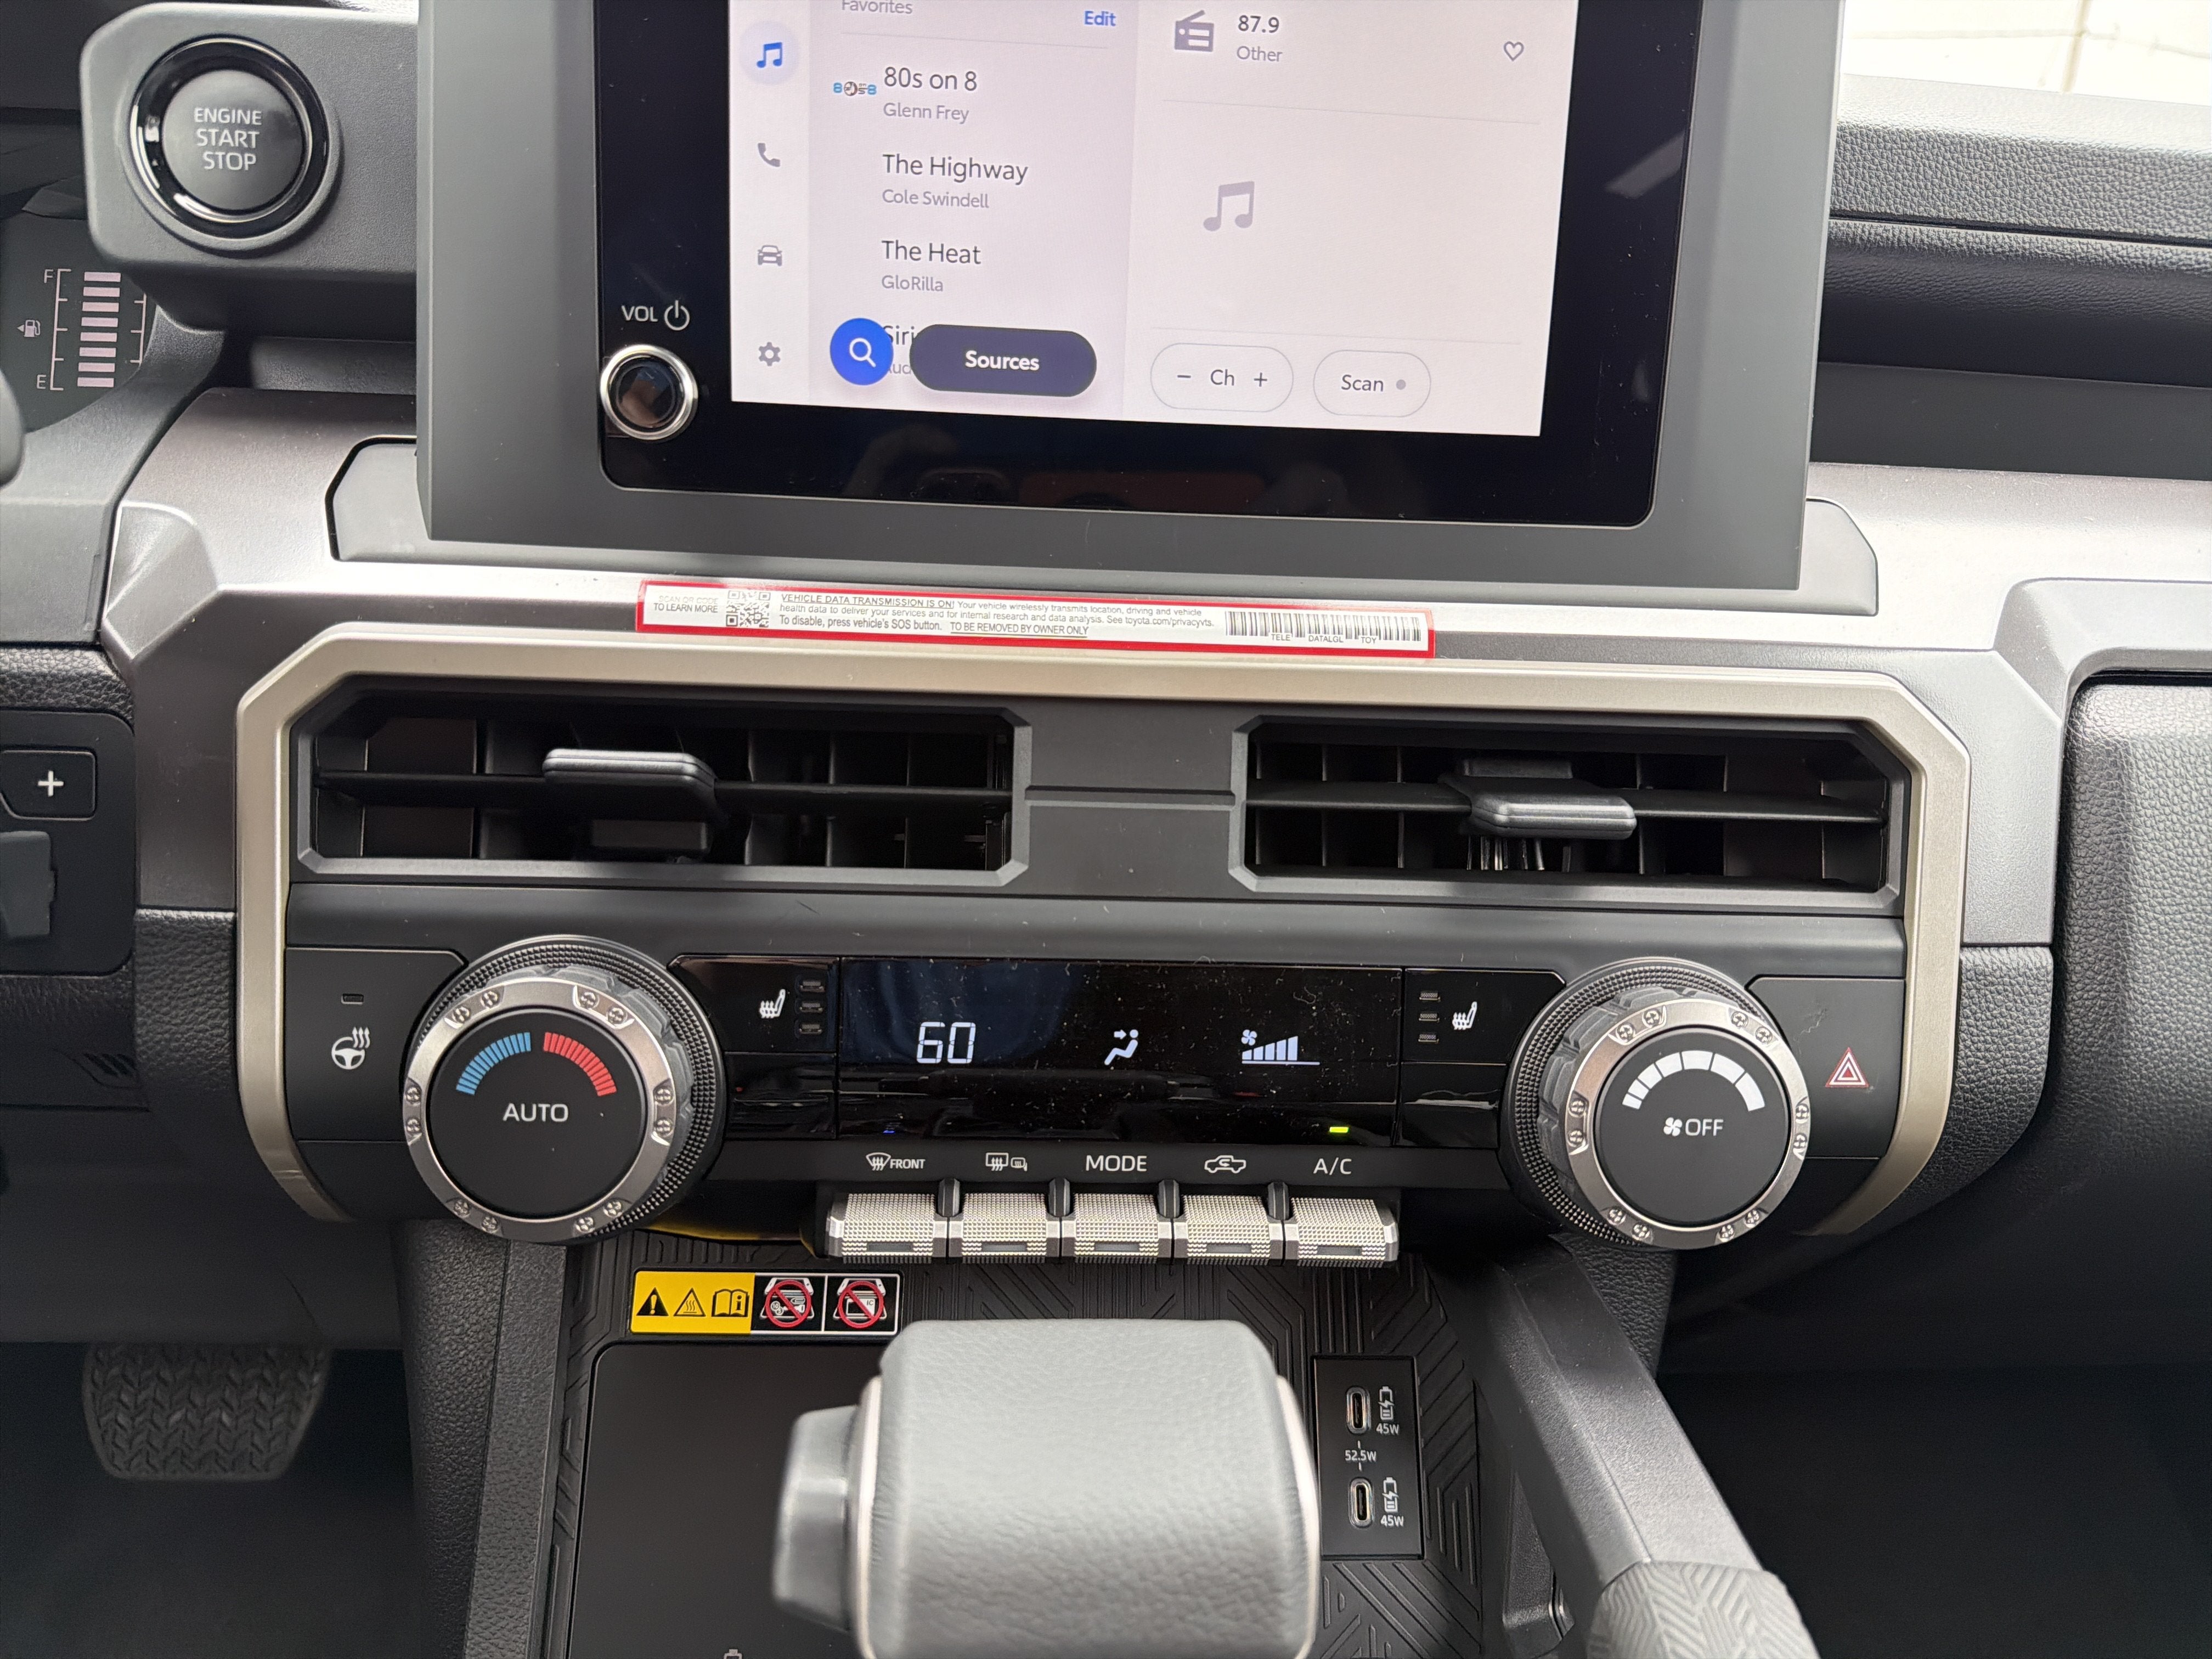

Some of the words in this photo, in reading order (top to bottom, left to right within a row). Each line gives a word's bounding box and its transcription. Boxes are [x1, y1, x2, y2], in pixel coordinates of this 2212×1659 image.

[1084, 10, 1116, 27] Edit
[1237, 15, 1280, 34] 87.9
[1236, 46, 1283, 63] Other
[884, 66, 923, 88] 80s
[929, 74, 958, 90] on
[964, 71, 978, 92] 8
[194, 107, 262, 126] ENGINE
[883, 102, 932, 119] Glenn
[936, 105, 969, 125] Frey
[196, 128, 259, 149] START
[203, 151, 257, 171] STOP
[882, 153, 923, 176] The
[929, 156, 1029, 185] Highway
[882, 189, 919, 205] Cole
[922, 191, 990, 208] Swindell
[881, 239, 922, 262] The
[928, 242, 981, 266] Heat
[43, 269, 54, 284] F
[881, 274, 944, 293] GloRilla
[620, 305, 658, 323] VOL
[964, 350, 1040, 371] Sources
[36, 374, 47, 390] E
[1209, 368, 1235, 387] Ch
[1340, 374, 1385, 393] Scan
[653, 603, 665, 611] TO
[666, 603, 692, 612] LEARN
[695, 605, 719, 613] MORE
[780, 603, 806, 612] health
[808, 605, 827, 613] data
[830, 606, 839, 614] to
[841, 606, 869, 615] deliver
[871, 608, 889, 618] your
[891, 609, 927, 617] services
[928, 610, 944, 618] and
[946, 610, 958, 619] for
[960, 611, 991, 619] internal
[993, 612, 1029, 620] research
[1048, 614, 1066, 622] data
[1069, 614, 1104, 625] analysis.
[1106, 615, 1123, 624] See
[781, 594, 822, 603] VEHICLE
[825, 595, 850, 604] DATA
[852, 596, 924, 607] TRANSMISSION
[926, 599, 935, 608] IS
[957, 601, 977, 609] Your
[978, 601, 1007, 610] vehicle
[1009, 603, 1049, 613] wirelessly
[1051, 605, 1088, 613] transmits
[1126, 607, 1154, 616] driving
[779, 614, 790, 625] To
[792, 615, 825, 628] disable,
[827, 618, 851, 629] press
[853, 617, 889, 629] vehicle's
[891, 618, 911, 630] SOS
[913, 619, 943, 631] button.
[950, 621, 962, 631] TO
[963, 622, 975, 631] BE
[977, 623, 1019, 633] REMOVED
[1020, 624, 1032, 633] BY
[1033, 625, 1065, 635] OWNER
[1066, 626, 1089, 635] ONLY
[1271, 633, 1291, 641] TELE
[1308, 635, 1344, 643] DATALGL
[1361, 636, 1378, 644] TOY
[916, 1021, 977, 1064] 60
[503, 1103, 569, 1122] AUTO
[1685, 1118, 1724, 1137] OFF
[889, 1158, 926, 1170] FRONT
[1085, 1154, 1148, 1173] MODE
[1313, 1157, 1352, 1175] A/C
[1376, 1423, 1400, 1435] 45W
[1345, 1449, 1377, 1462] 52.5W
[1380, 1514, 1404, 1527] 45W
